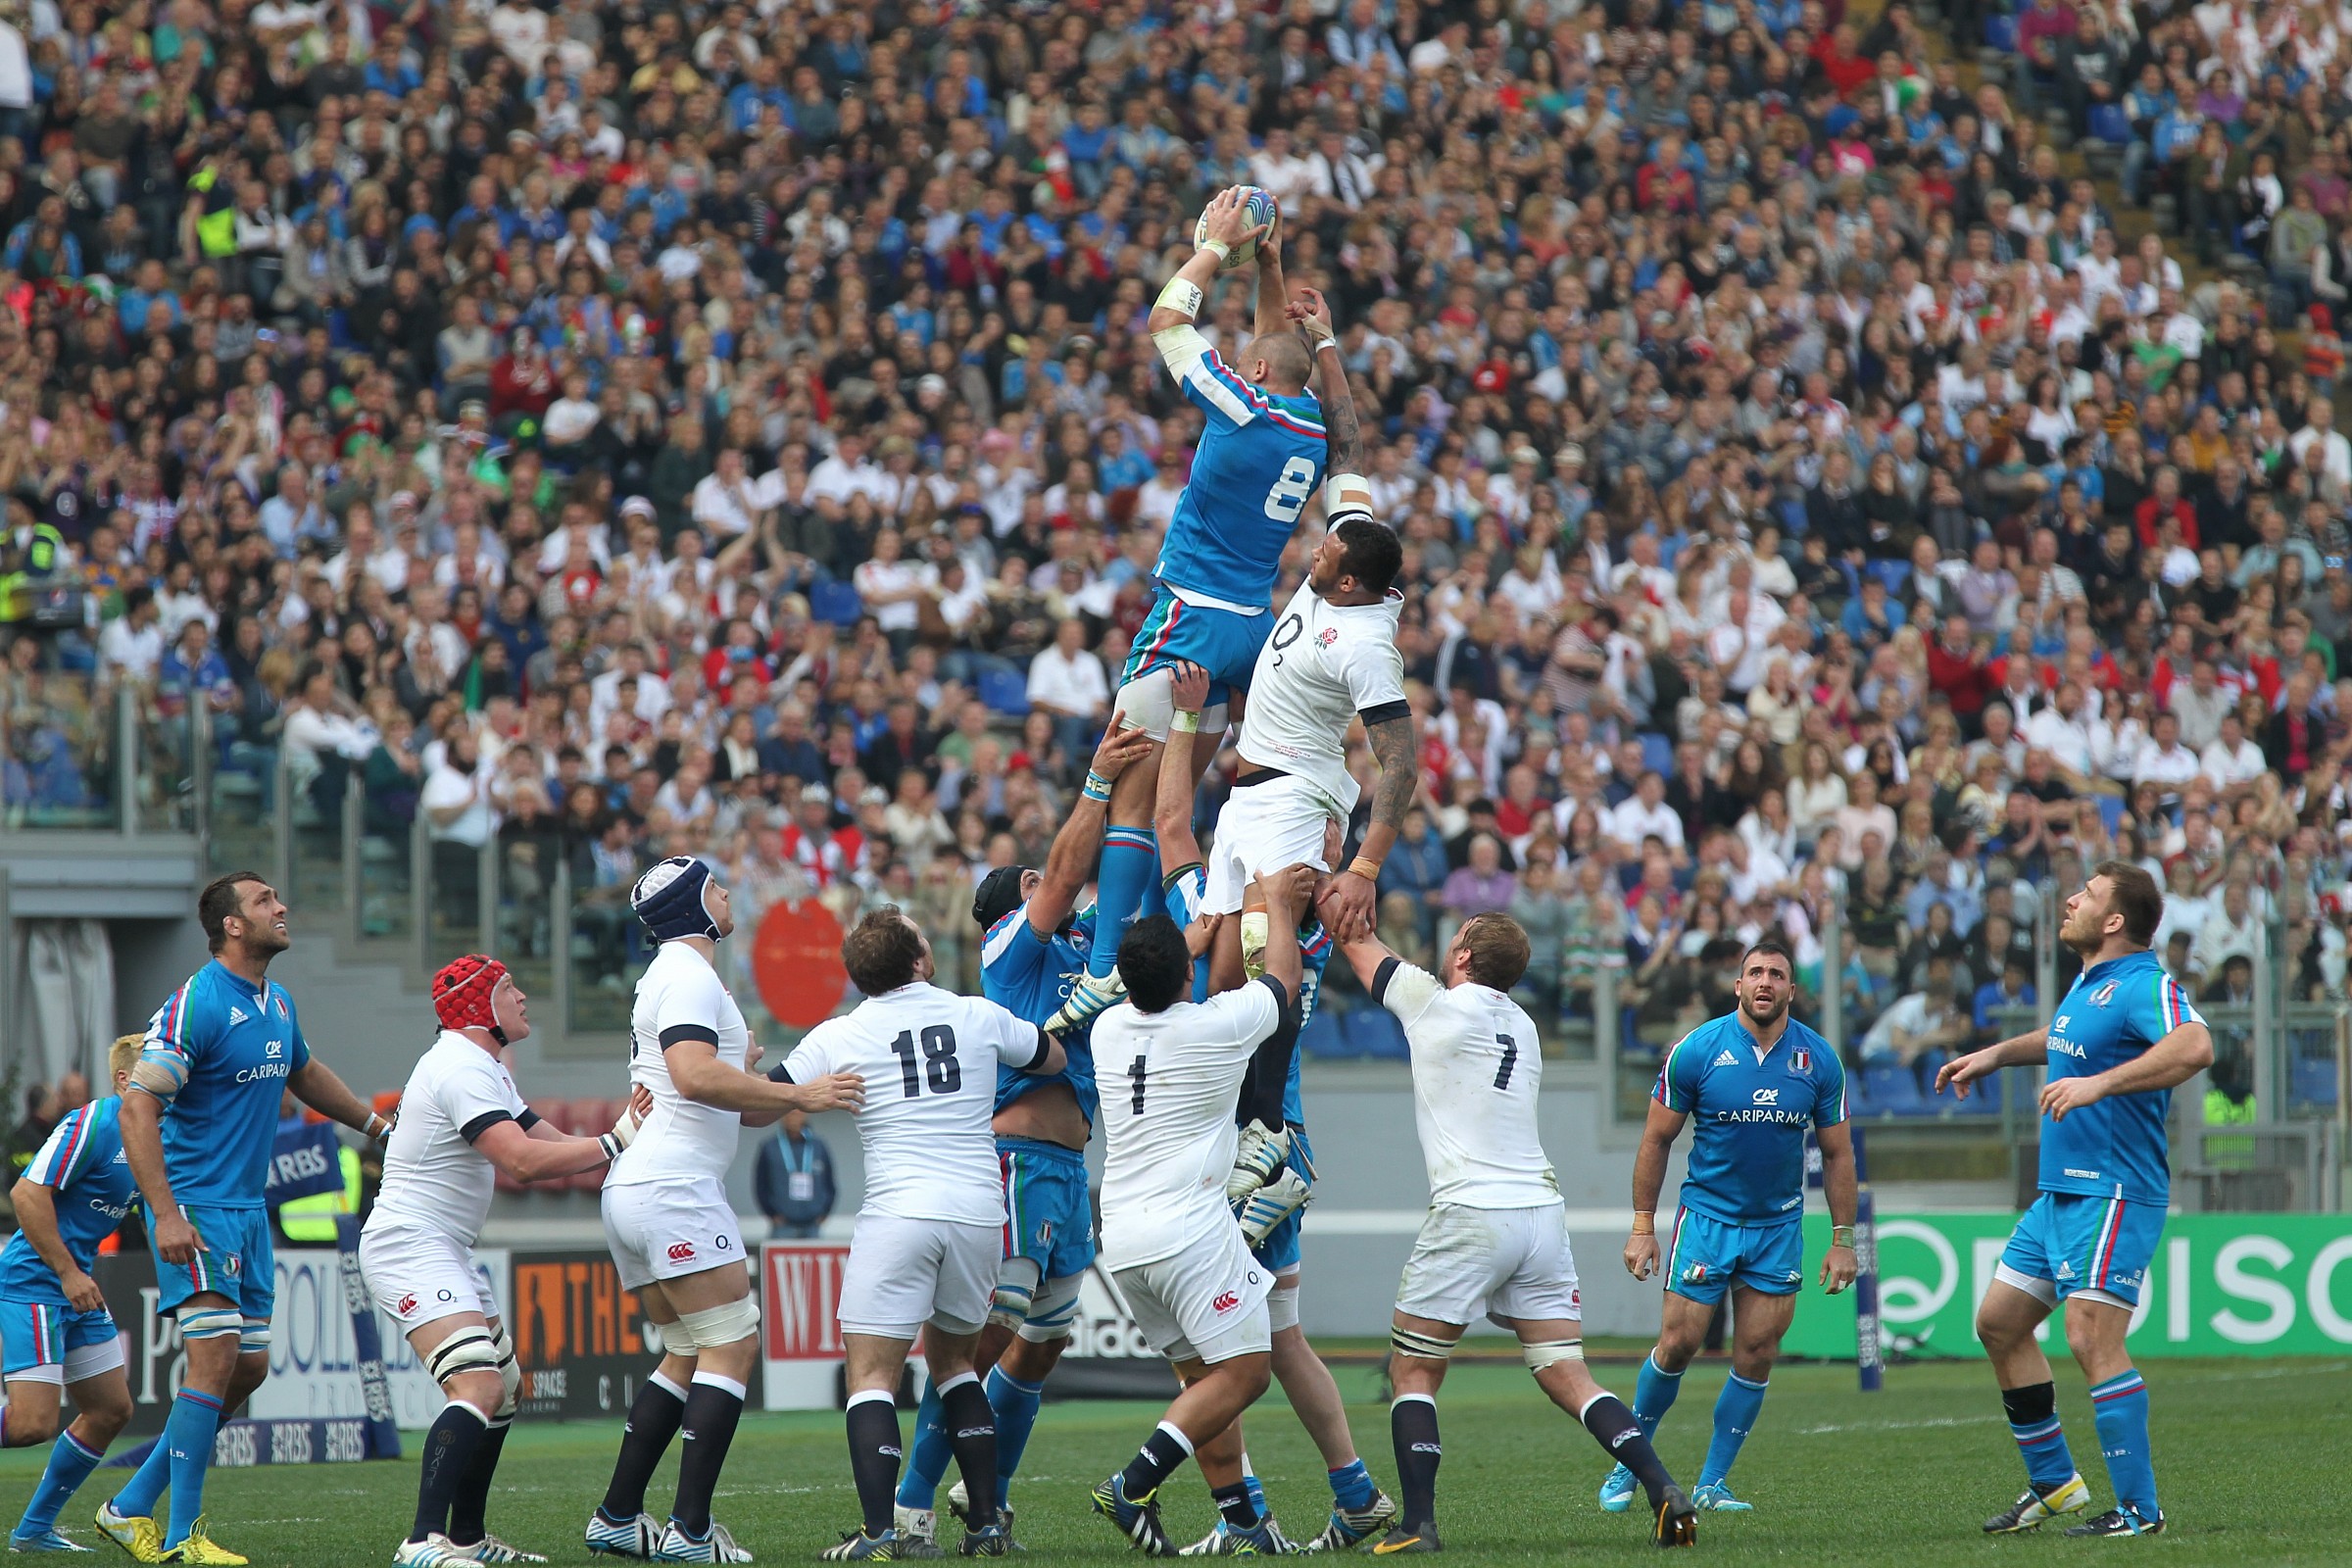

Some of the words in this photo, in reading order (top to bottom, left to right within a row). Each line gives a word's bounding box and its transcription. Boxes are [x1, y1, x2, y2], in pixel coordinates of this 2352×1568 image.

[1264, 456, 1315, 522] 8
[891, 1024, 963, 1099] 18
[1127, 1054, 1148, 1115] 1
[1493, 1033, 1517, 1091] 7
[274, 1144, 329, 1185] RBS
[437, 1289, 459, 1303] O2
[772, 1253, 849, 1353] WI
[1059, 1314, 1162, 1359] dida
